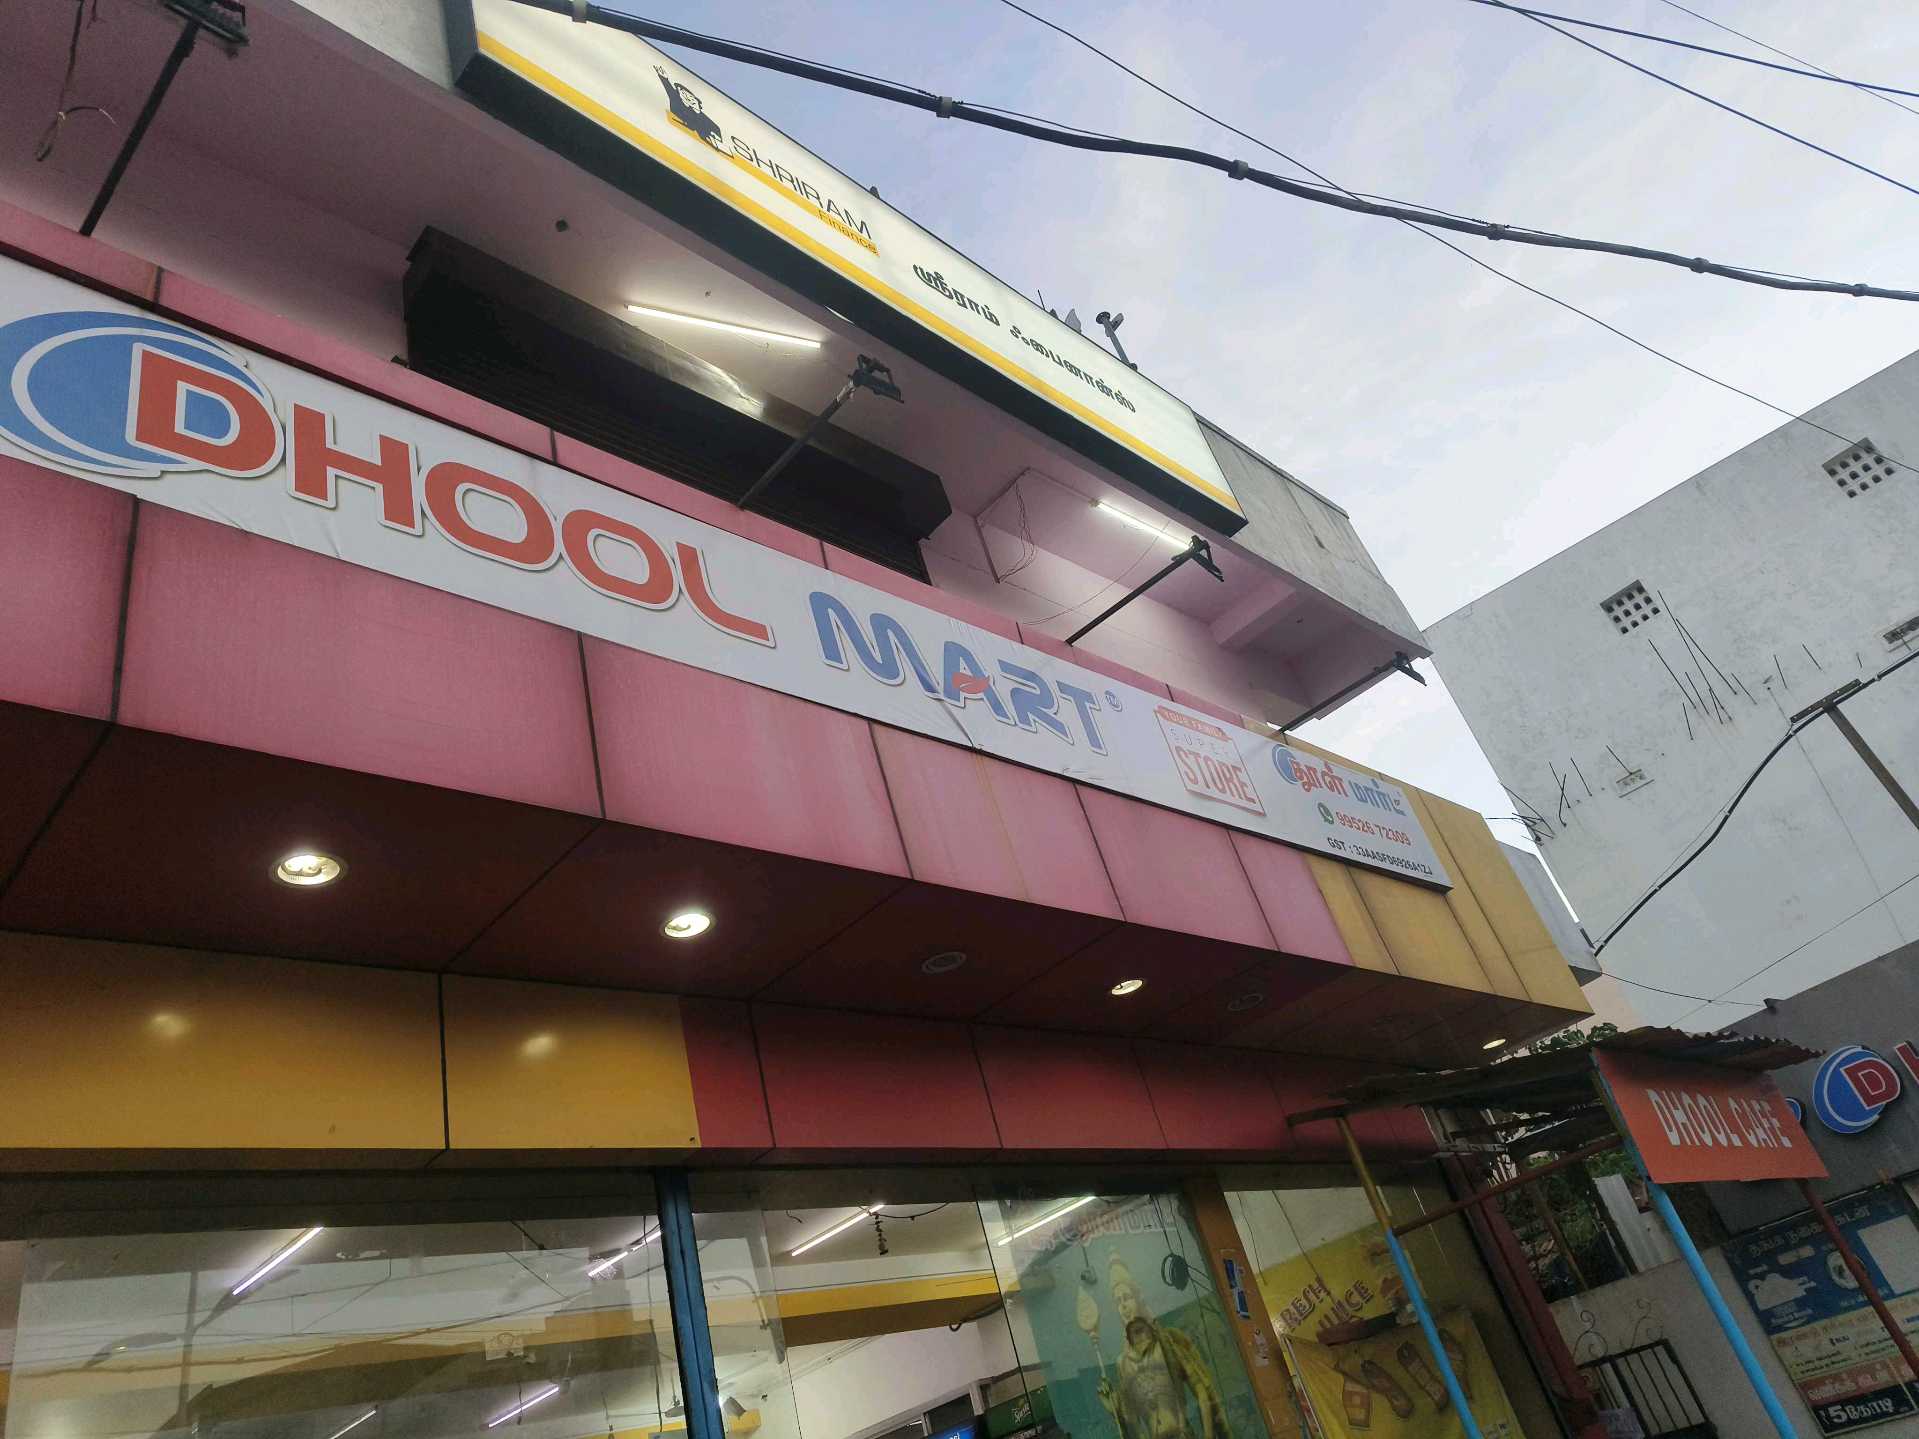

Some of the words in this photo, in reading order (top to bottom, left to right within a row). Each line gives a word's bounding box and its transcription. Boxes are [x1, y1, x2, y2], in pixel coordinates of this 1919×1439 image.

[731, 135, 872, 239] SHRIRAM
[817, 209, 879, 255] Finance
[1009, 325, 1136, 413] ஃபைனான்ஸ்
[127, 342, 776, 648] DHOOL
[808, 591, 1108, 756] MART
[1174, 745, 1257, 804] STORE
[1326, 837, 1346, 853] GST
[1335, 811, 1375, 836] 99526
[1645, 1088, 1743, 1147] DHOOL
[1728, 1096, 1793, 1148] CAFE
